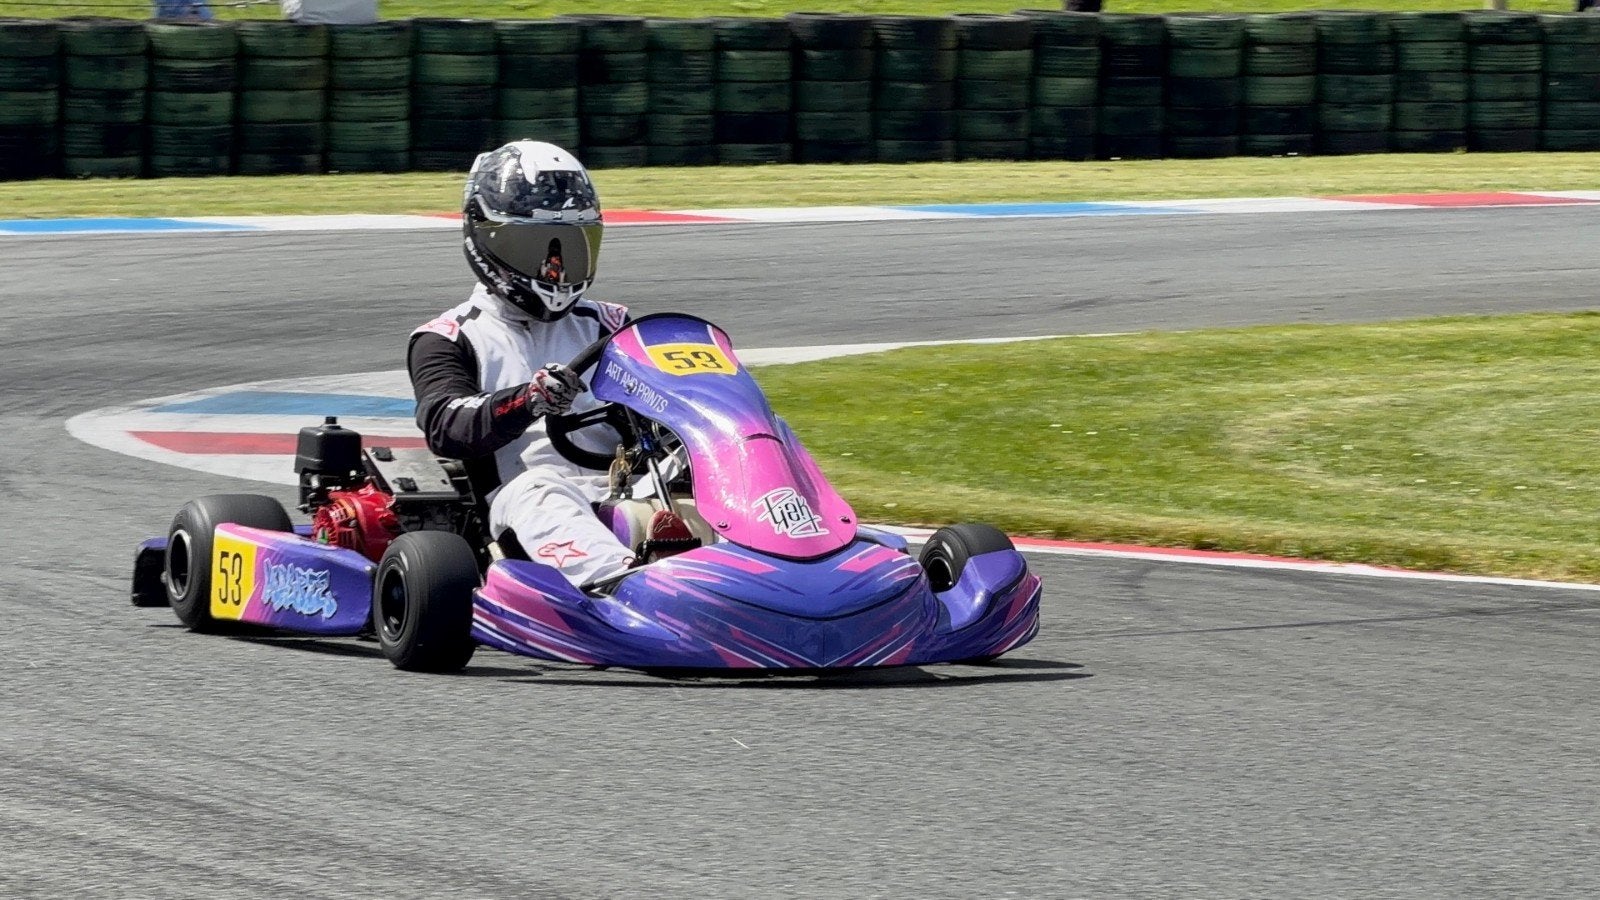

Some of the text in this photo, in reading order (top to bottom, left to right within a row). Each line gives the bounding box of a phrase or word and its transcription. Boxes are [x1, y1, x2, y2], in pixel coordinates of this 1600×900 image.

[605, 360, 623, 383] ART
[635, 382, 668, 413] PRINTS
[662, 351, 723, 370] 53
[219, 551, 242, 606] 53
